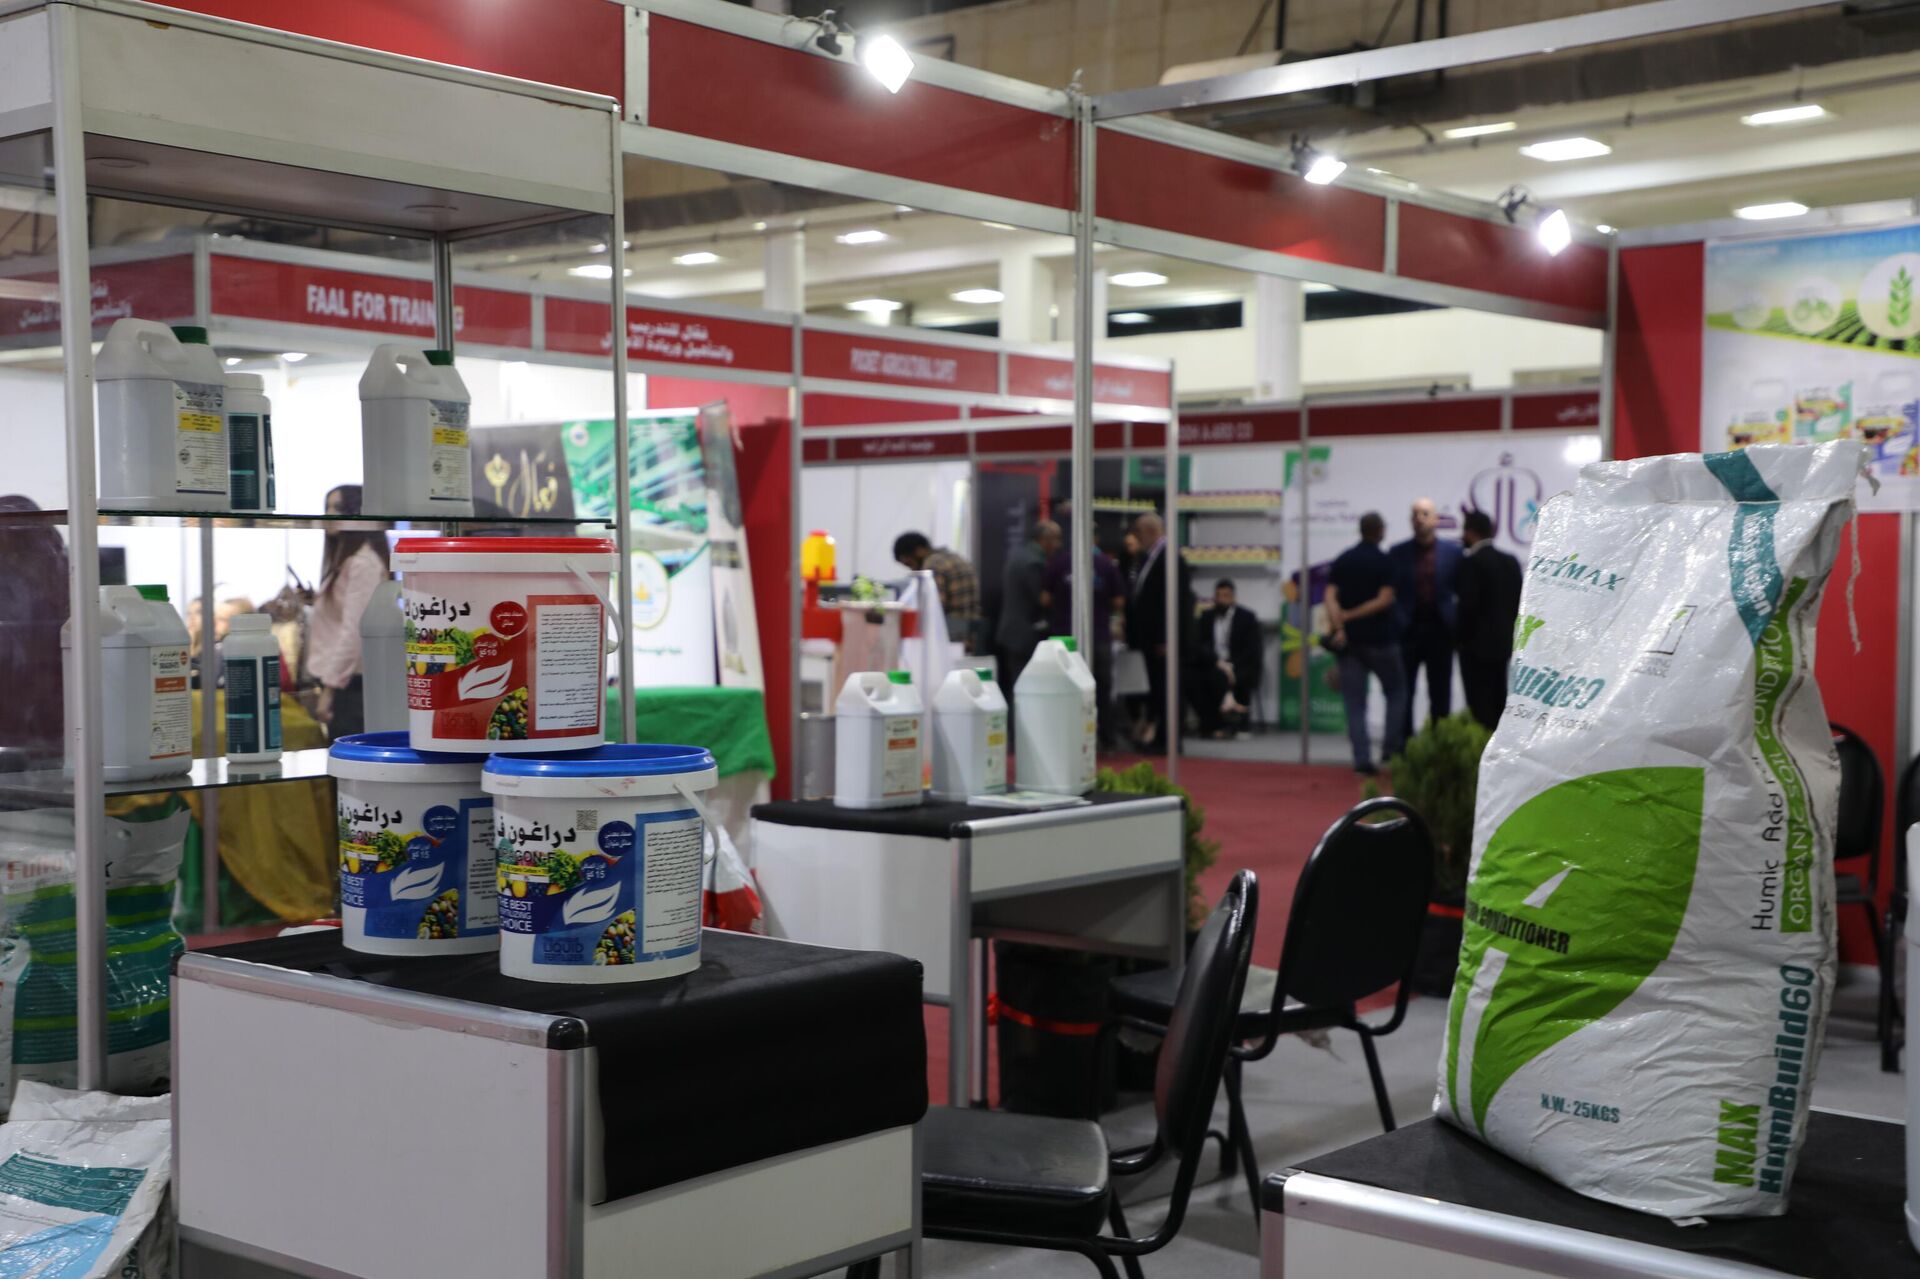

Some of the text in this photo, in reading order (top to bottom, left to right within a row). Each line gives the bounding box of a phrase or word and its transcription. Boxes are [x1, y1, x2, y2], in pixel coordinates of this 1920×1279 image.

[306, 284, 464, 332] FAAL FOR TRAING
[412, 596, 472, 623] دراغون
[509, 820, 577, 849] دراغون
[1759, 792, 1784, 843] Acid
[595, 870, 606, 879] 15
[1785, 802, 1811, 925] ORGANIC
[510, 900, 534, 912] BEST
[1749, 859, 1780, 932] Humic
[1479, 905, 1572, 955] CONDITIONER
[1758, 963, 1815, 1195] HumBuild60
[1572, 1099, 1621, 1124] 25KGS
[1712, 1099, 1761, 1188] MAX
